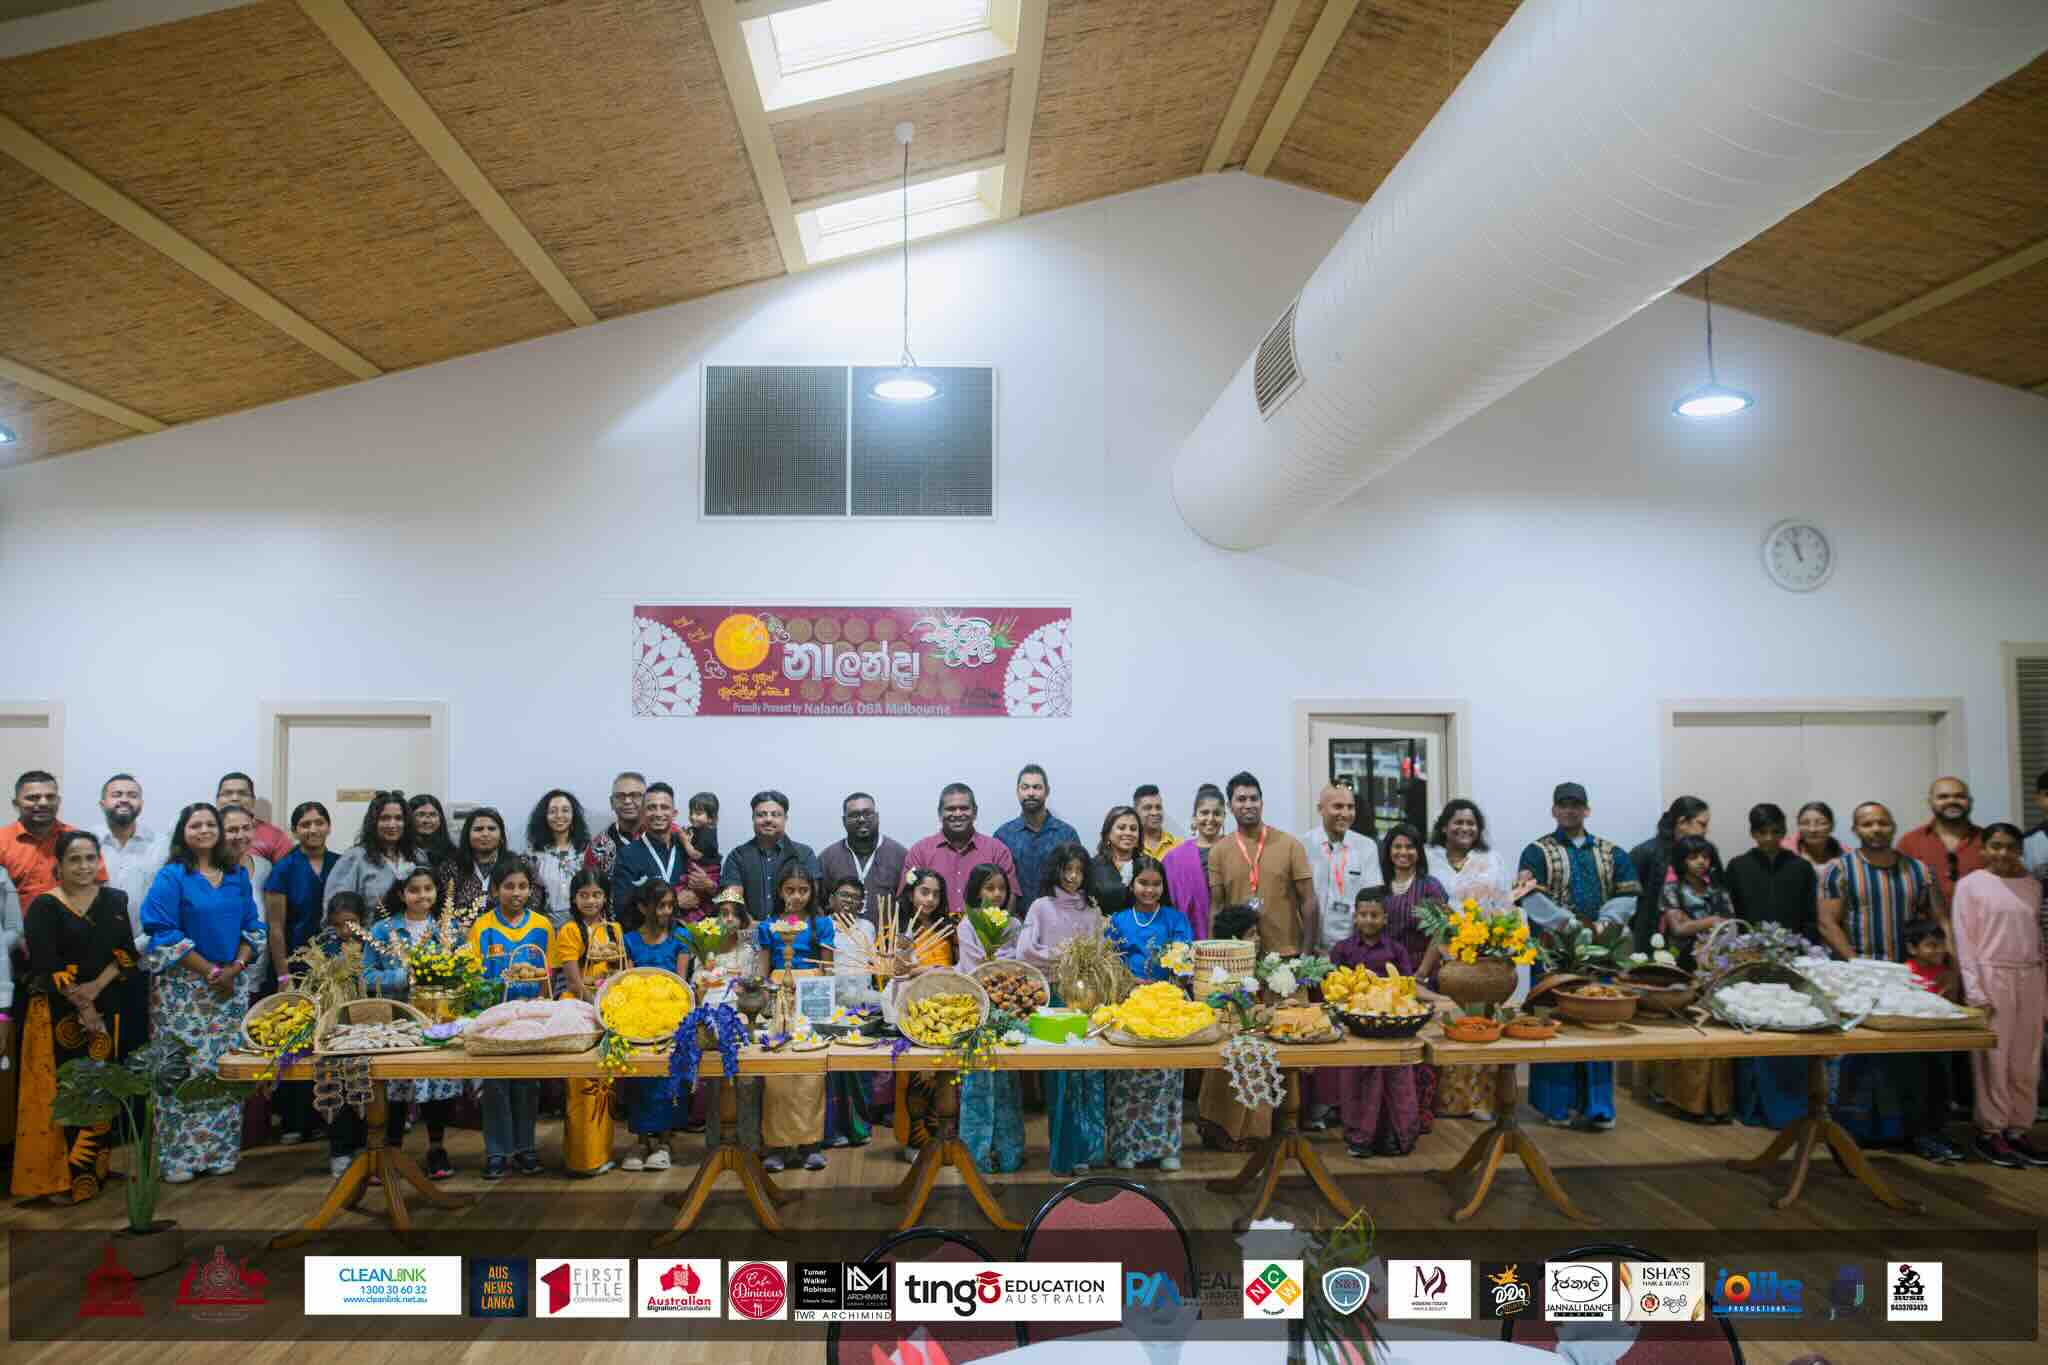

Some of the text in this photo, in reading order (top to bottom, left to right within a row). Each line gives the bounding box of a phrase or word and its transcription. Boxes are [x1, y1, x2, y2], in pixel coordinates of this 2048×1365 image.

[804, 703, 853, 714] Nalanda
[857, 703, 882, 714] OBA
[886, 703, 950, 714] Melbourne
